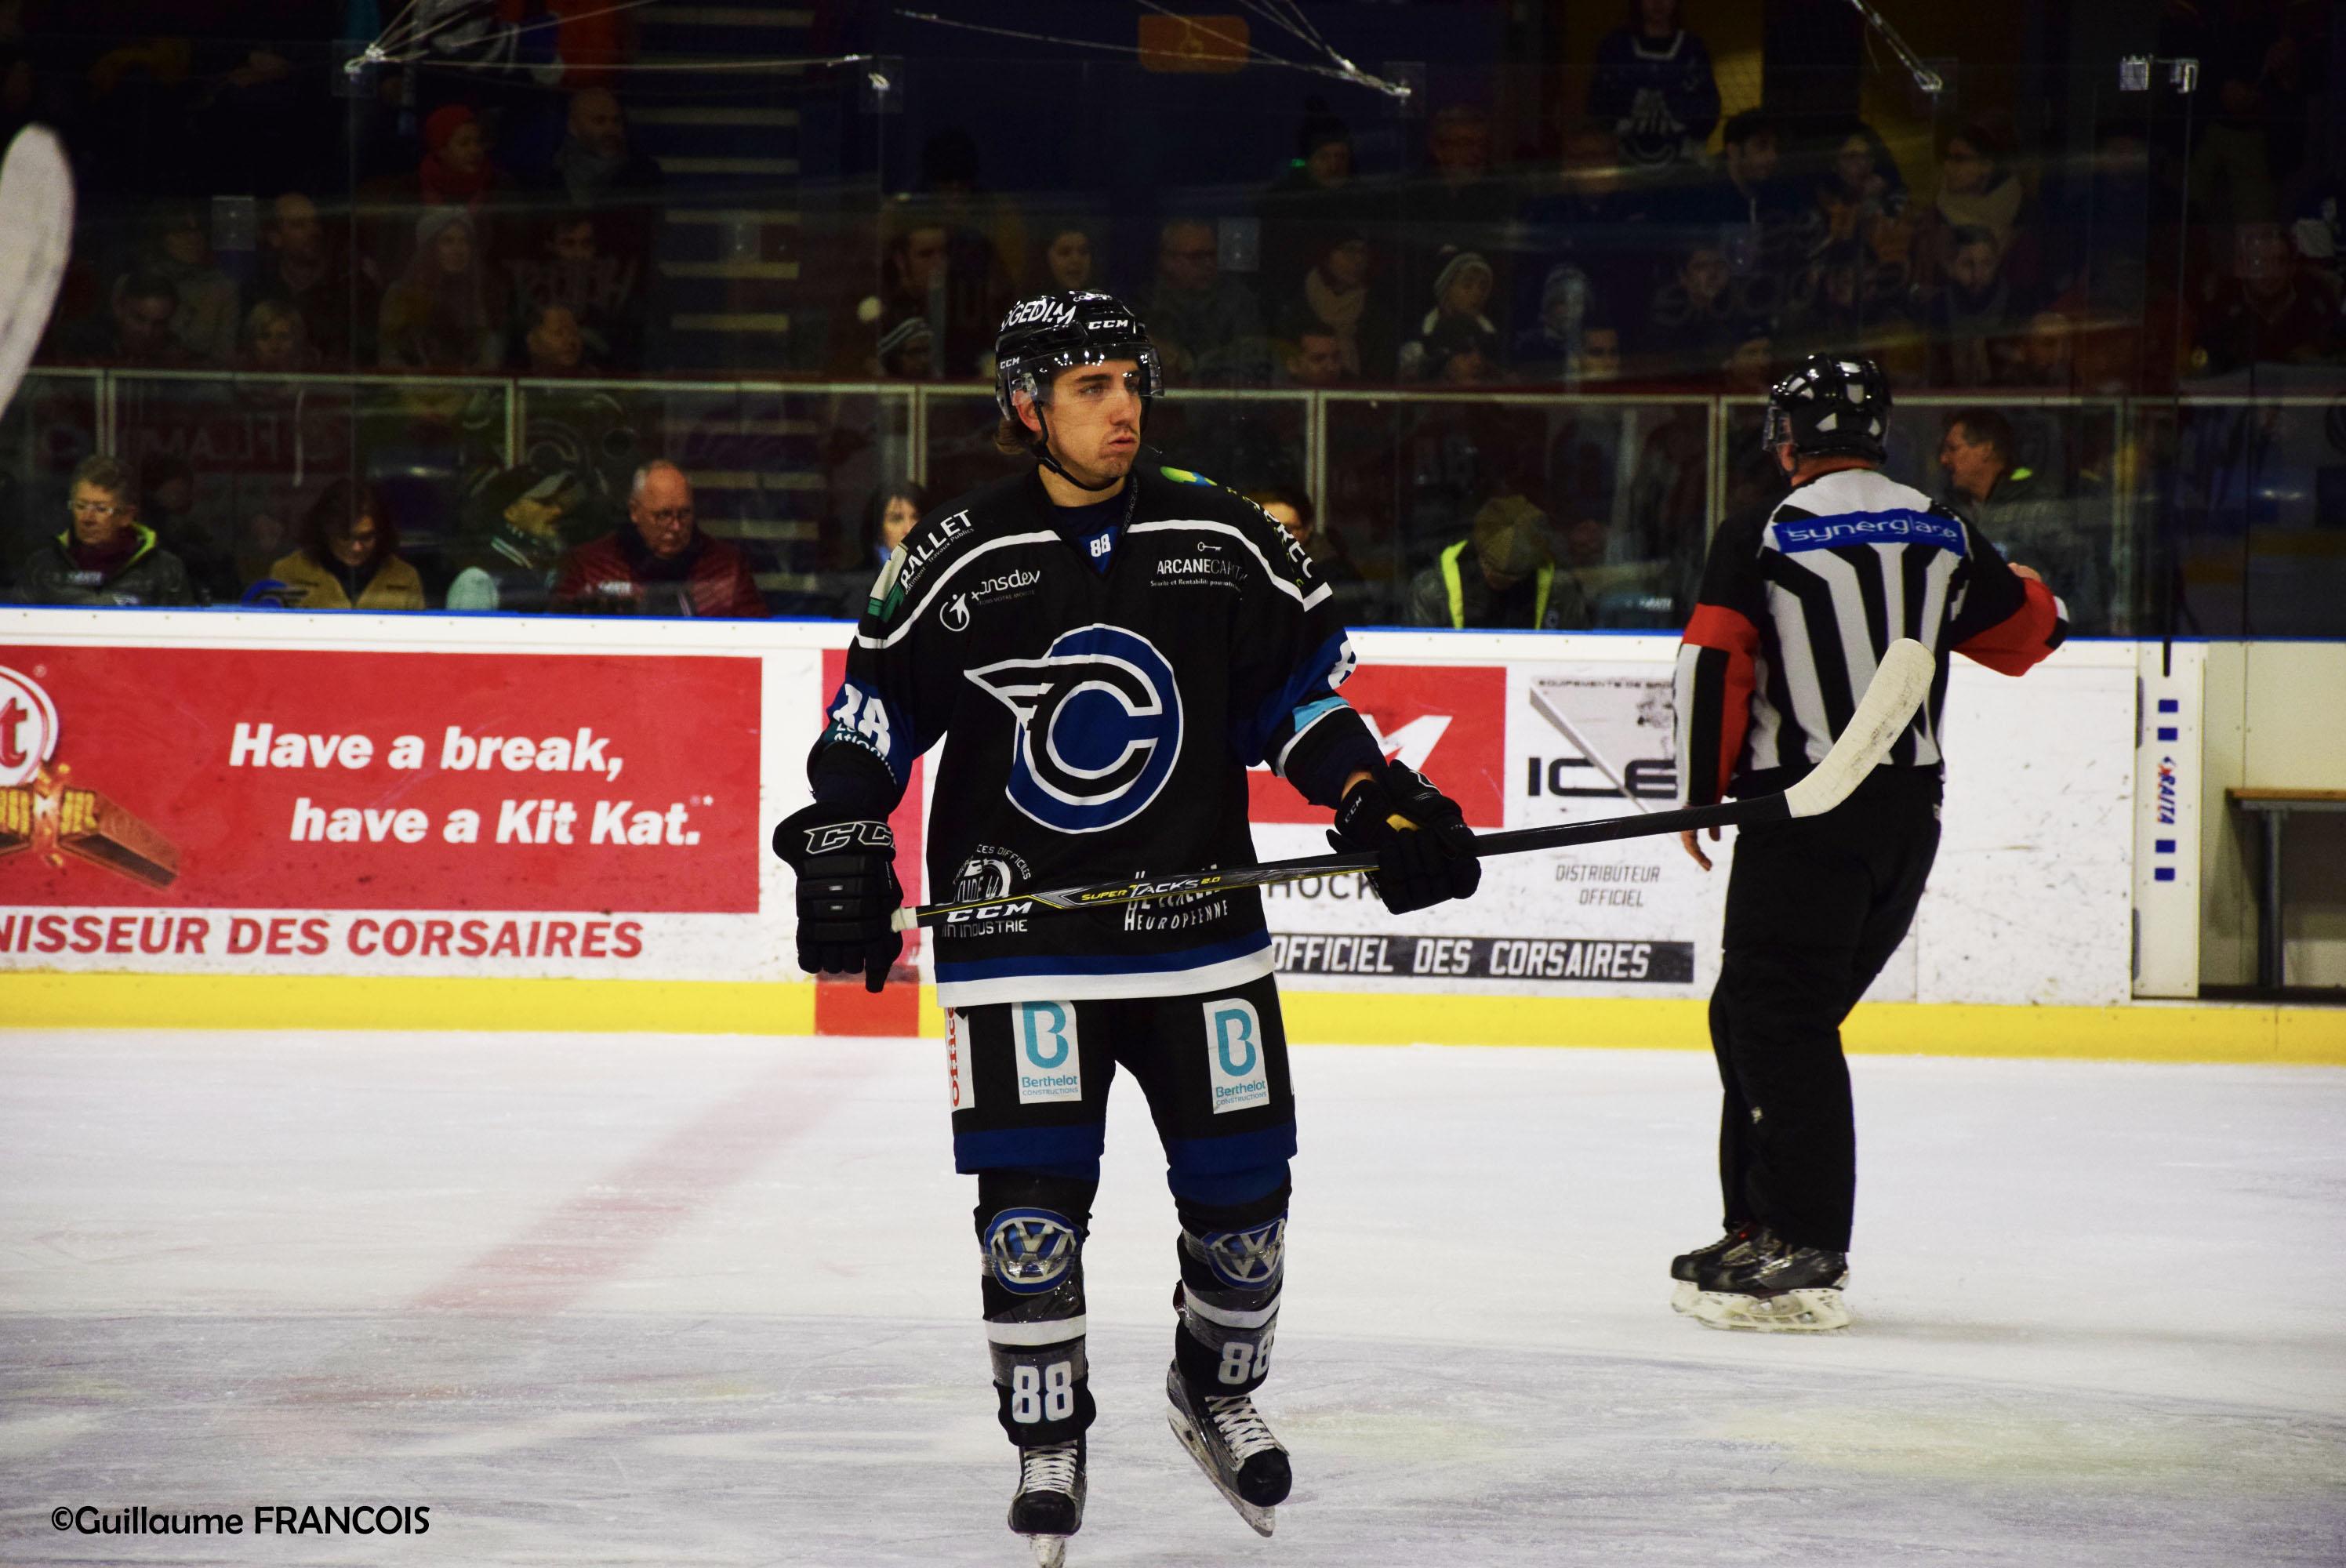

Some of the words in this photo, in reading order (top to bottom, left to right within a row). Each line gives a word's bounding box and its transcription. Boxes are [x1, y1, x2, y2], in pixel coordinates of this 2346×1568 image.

[1088, 319, 1128, 330] CCM
[1000, 357, 1020, 369] CCM
[928, 543, 950, 564] Travaux
[950, 528, 975, 543] Publics
[1090, 534, 1111, 557] 88
[229, 723, 374, 769] Have
[387, 735, 424, 770] a
[442, 726, 624, 781] break,
[1344, 795, 1363, 824] CCM
[290, 799, 428, 842] have
[443, 809, 478, 843] a
[496, 800, 578, 845] Kit
[803, 821, 895, 855] CC
[1556, 865, 1660, 883] DISTRIBUTEUR
[1578, 889, 1644, 907] OFFICIEL
[946, 902, 1033, 923] CCM
[227, 917, 329, 955] DES
[347, 920, 644, 959] CORSAIRES
[960, 919, 1028, 938] INDUSTRIE
[1273, 935, 1394, 973] OFFICIEL
[1413, 939, 1473, 975] DES
[1490, 941, 1651, 978] CORSAIRES
[1022, 1075, 1078, 1088] Berthelot
[1022, 1087, 1079, 1096] CONSTRUCTIONS
[1216, 1080, 1266, 1098] Berthelot
[1216, 1092, 1267, 1106] CONSTRUCTIONS
[1217, 1334, 1274, 1385] 88
[1011, 1361, 1073, 1424] 88
